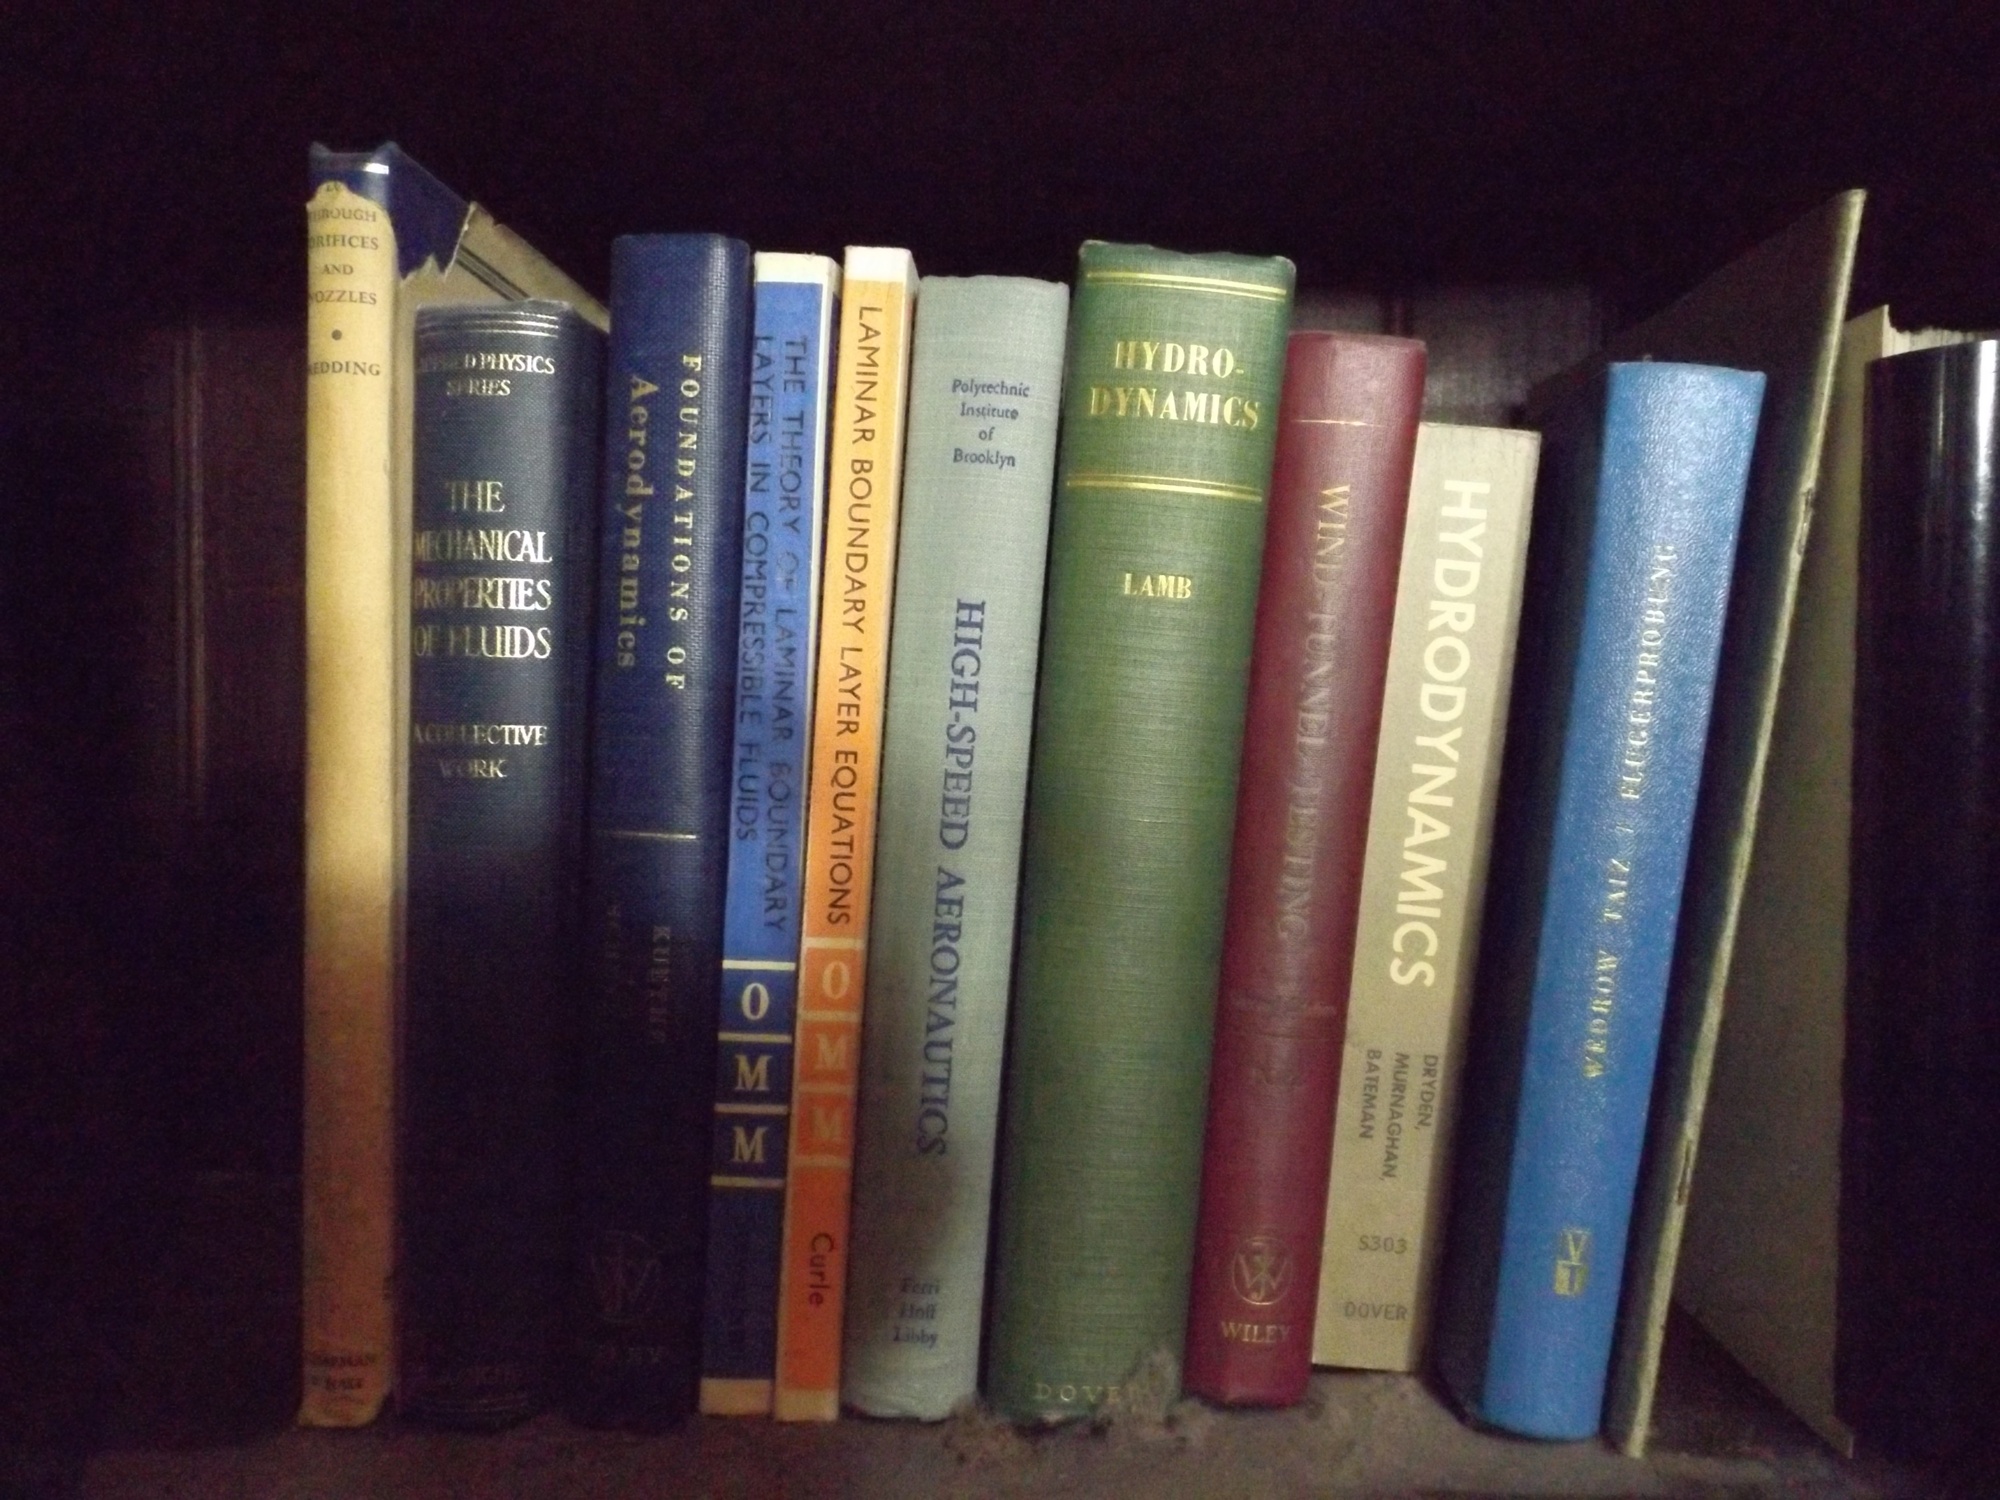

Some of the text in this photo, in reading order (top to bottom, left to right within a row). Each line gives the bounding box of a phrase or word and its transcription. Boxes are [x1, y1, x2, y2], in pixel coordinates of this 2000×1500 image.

[321, 263, 354, 275] AND
[783, 335, 808, 396] THE
[1114, 340, 1245, 379] HYDRO-
[951, 379, 1031, 398] Polytechnic
[960, 402, 1019, 420] Institute
[1089, 386, 1262, 431] DYNAMICS
[952, 447, 1016, 470] Brooklyn
[978, 426, 996, 441] of
[447, 481, 505, 513] THE
[749, 461, 772, 494] IN
[778, 408, 805, 534] THEORY
[614, 374, 660, 668] Aerodynamics
[665, 354, 702, 690] FOUNDATIONS OF
[1123, 572, 1192, 599] LAMB
[827, 305, 884, 927] LAMINAR BOUNDARY LAYER EQUATIONS
[769, 606, 799, 743] LAMINAR
[1388, 478, 1492, 989] HYDRODYNAMICS
[734, 742, 762, 843] FLUIDS
[916, 598, 987, 1157] HIGH-SPEED AERONAUTICS
[1358, 1049, 1384, 1140] BATEMAN
[1379, 1051, 1411, 1182] MURNAGHAN,
[1414, 1053, 1440, 1131] DRYDEN,
[808, 1232, 836, 1308] Curle
[1358, 1234, 1409, 1255] S303
[1220, 1320, 1292, 1344] WILEY
[1343, 1300, 1409, 1322] DOVER
